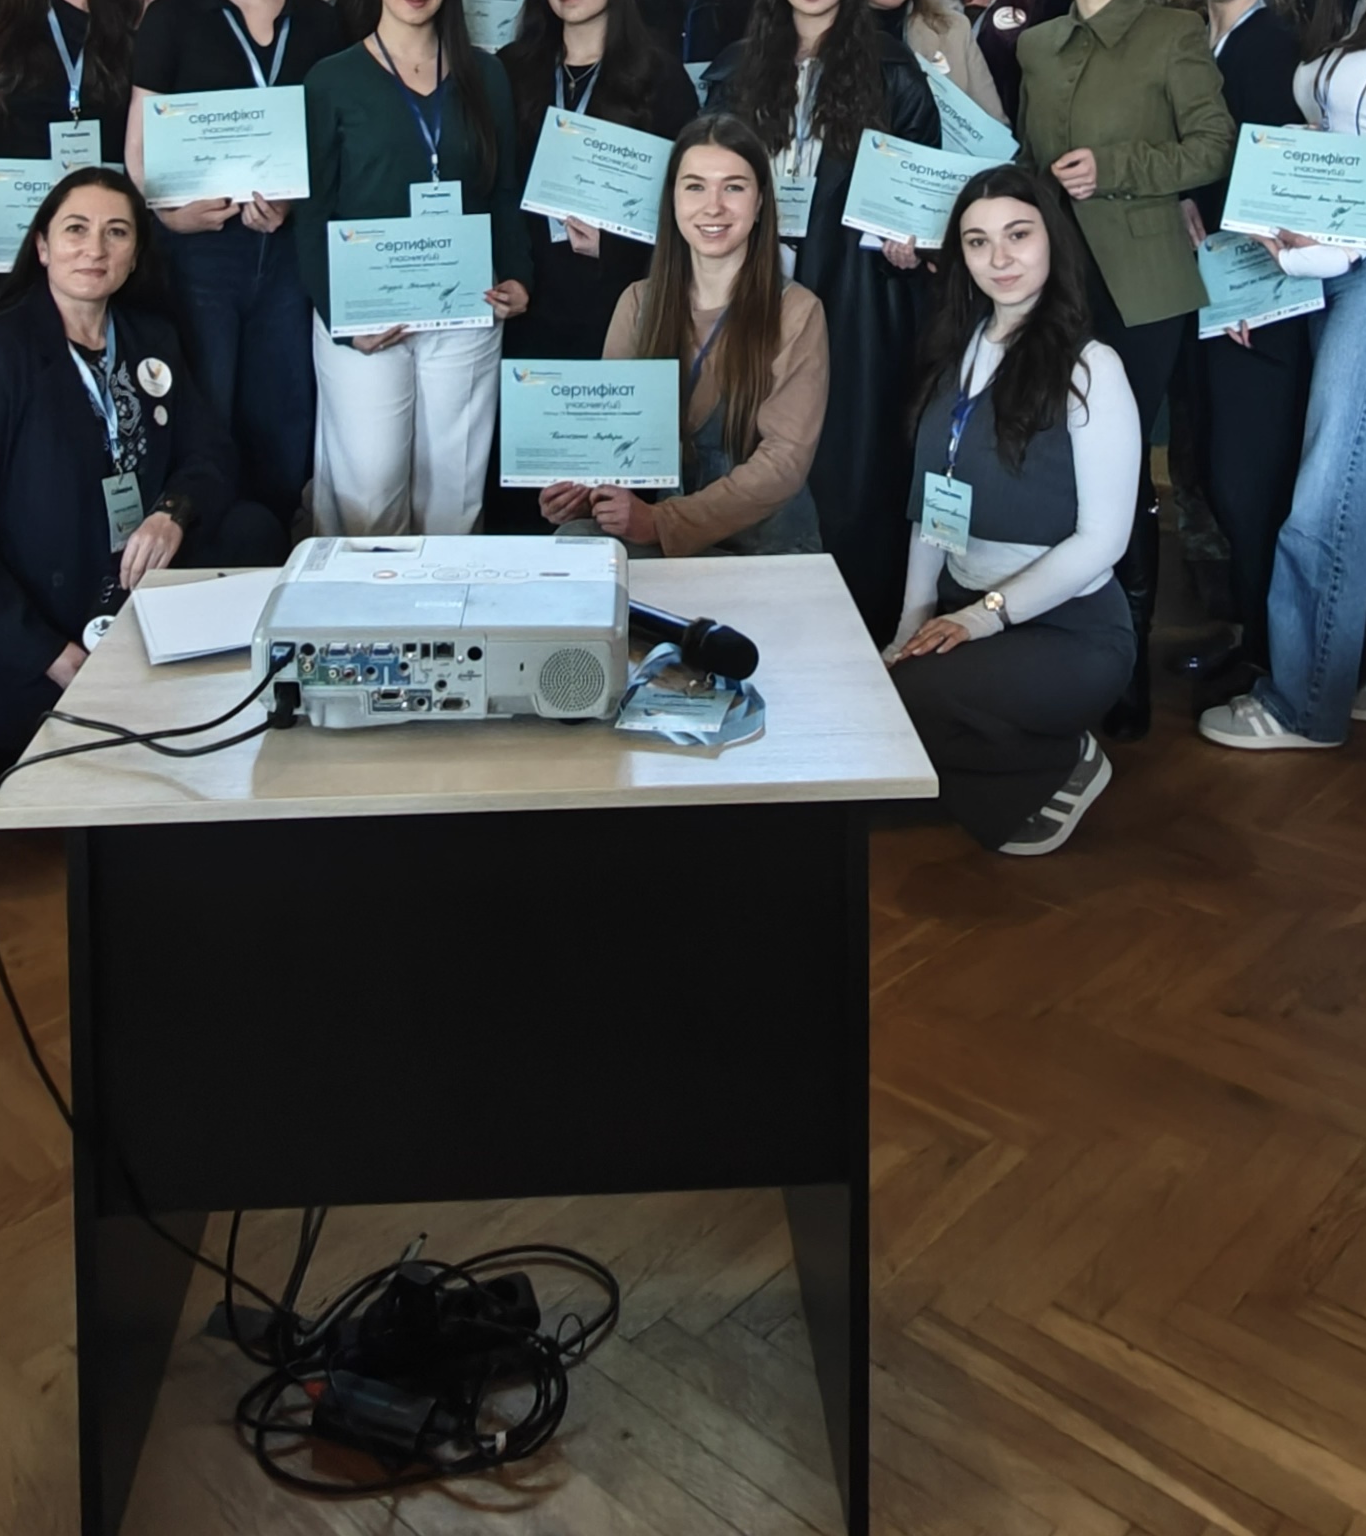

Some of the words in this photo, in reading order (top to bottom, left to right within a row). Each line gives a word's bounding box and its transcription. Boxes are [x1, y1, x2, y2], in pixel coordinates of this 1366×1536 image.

[188, 109, 265, 125] сертифікат
[583, 136, 653, 164] сертифікат
[1282, 148, 1361, 167] сертифікат
[375, 237, 453, 253] сертифікат
[550, 383, 636, 399] сертифікат
